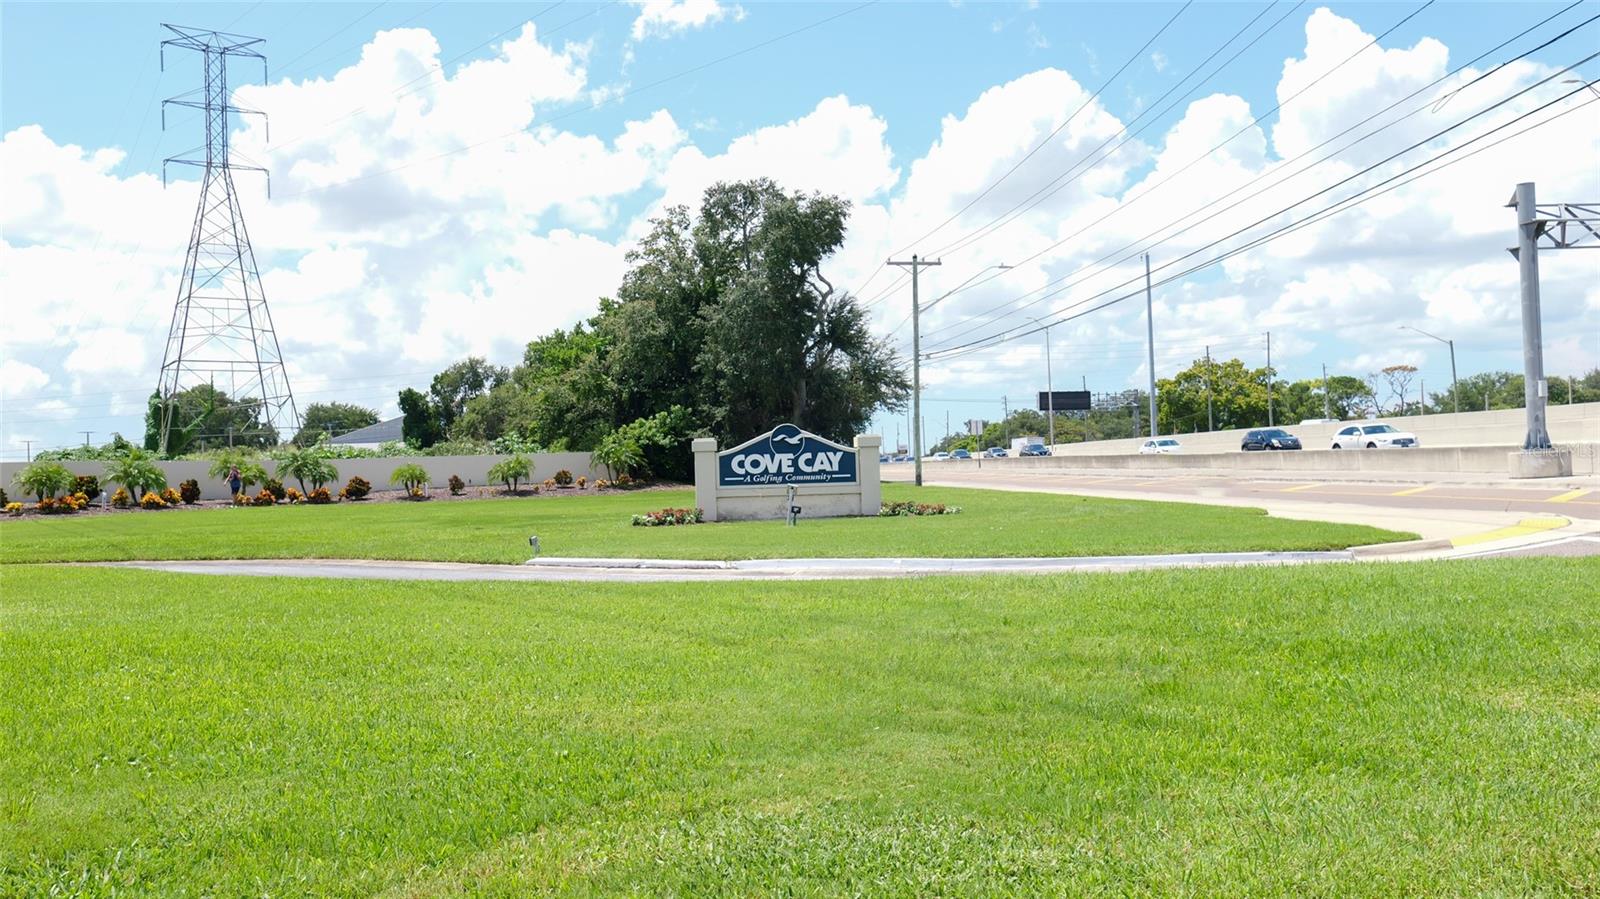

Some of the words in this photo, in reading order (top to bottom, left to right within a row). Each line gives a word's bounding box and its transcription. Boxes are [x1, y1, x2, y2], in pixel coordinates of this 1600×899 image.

[731, 453, 794, 474] COVE
[798, 451, 843, 472] CAY
[753, 475, 783, 484] Golfing
[785, 474, 832, 482] Community
